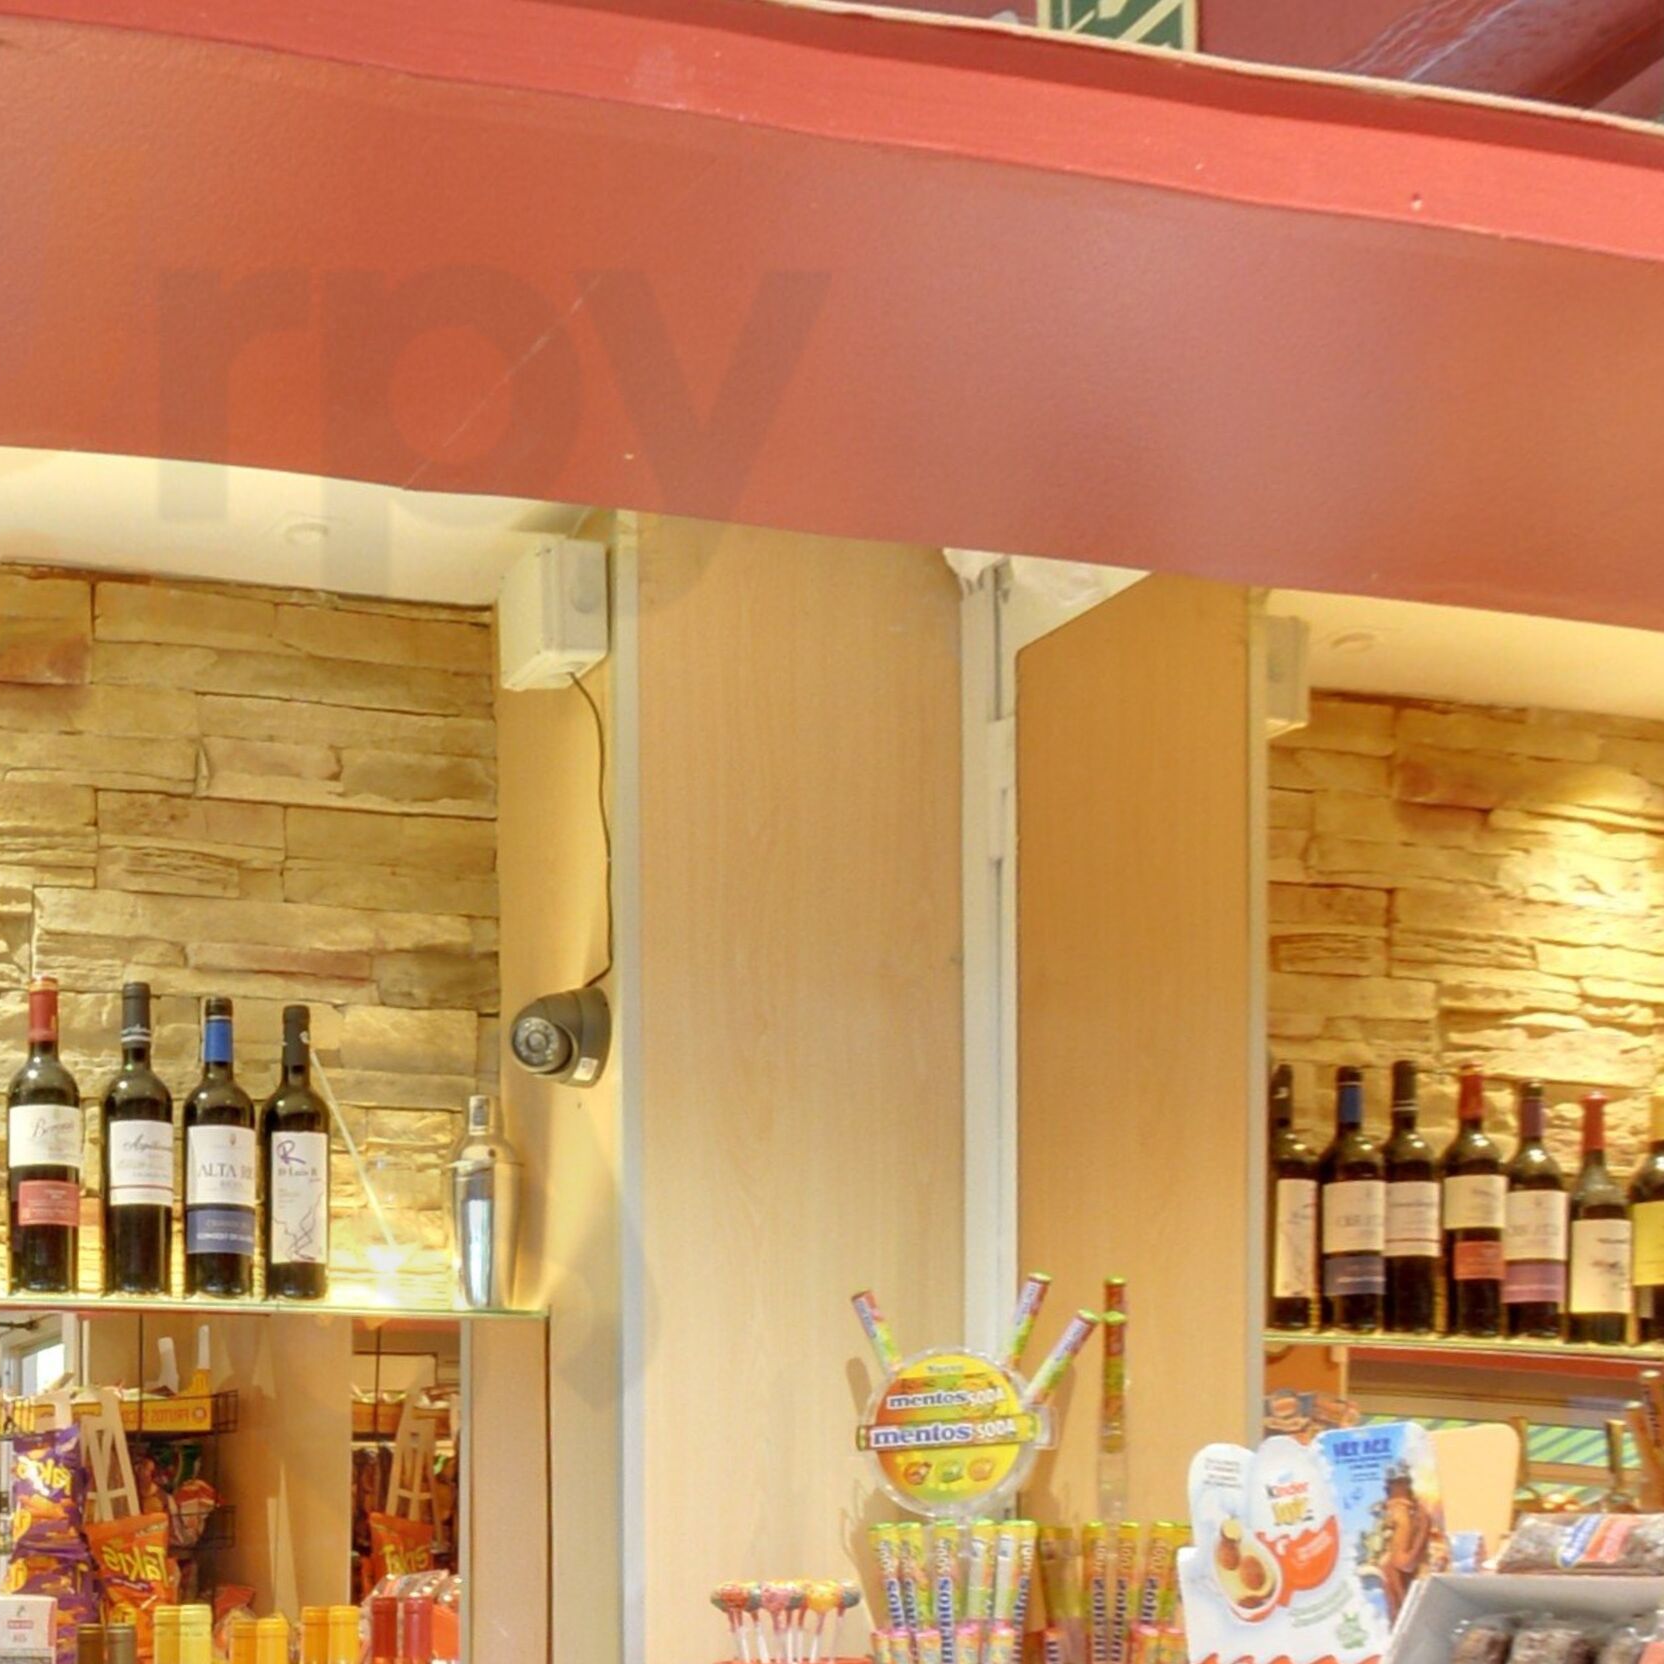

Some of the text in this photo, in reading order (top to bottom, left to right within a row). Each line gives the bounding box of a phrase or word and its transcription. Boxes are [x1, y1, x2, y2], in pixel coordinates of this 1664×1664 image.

[198, 1163, 236, 1179] ALTA
[889, 1393, 967, 1409] mentos
[873, 1423, 973, 1446] mentos
